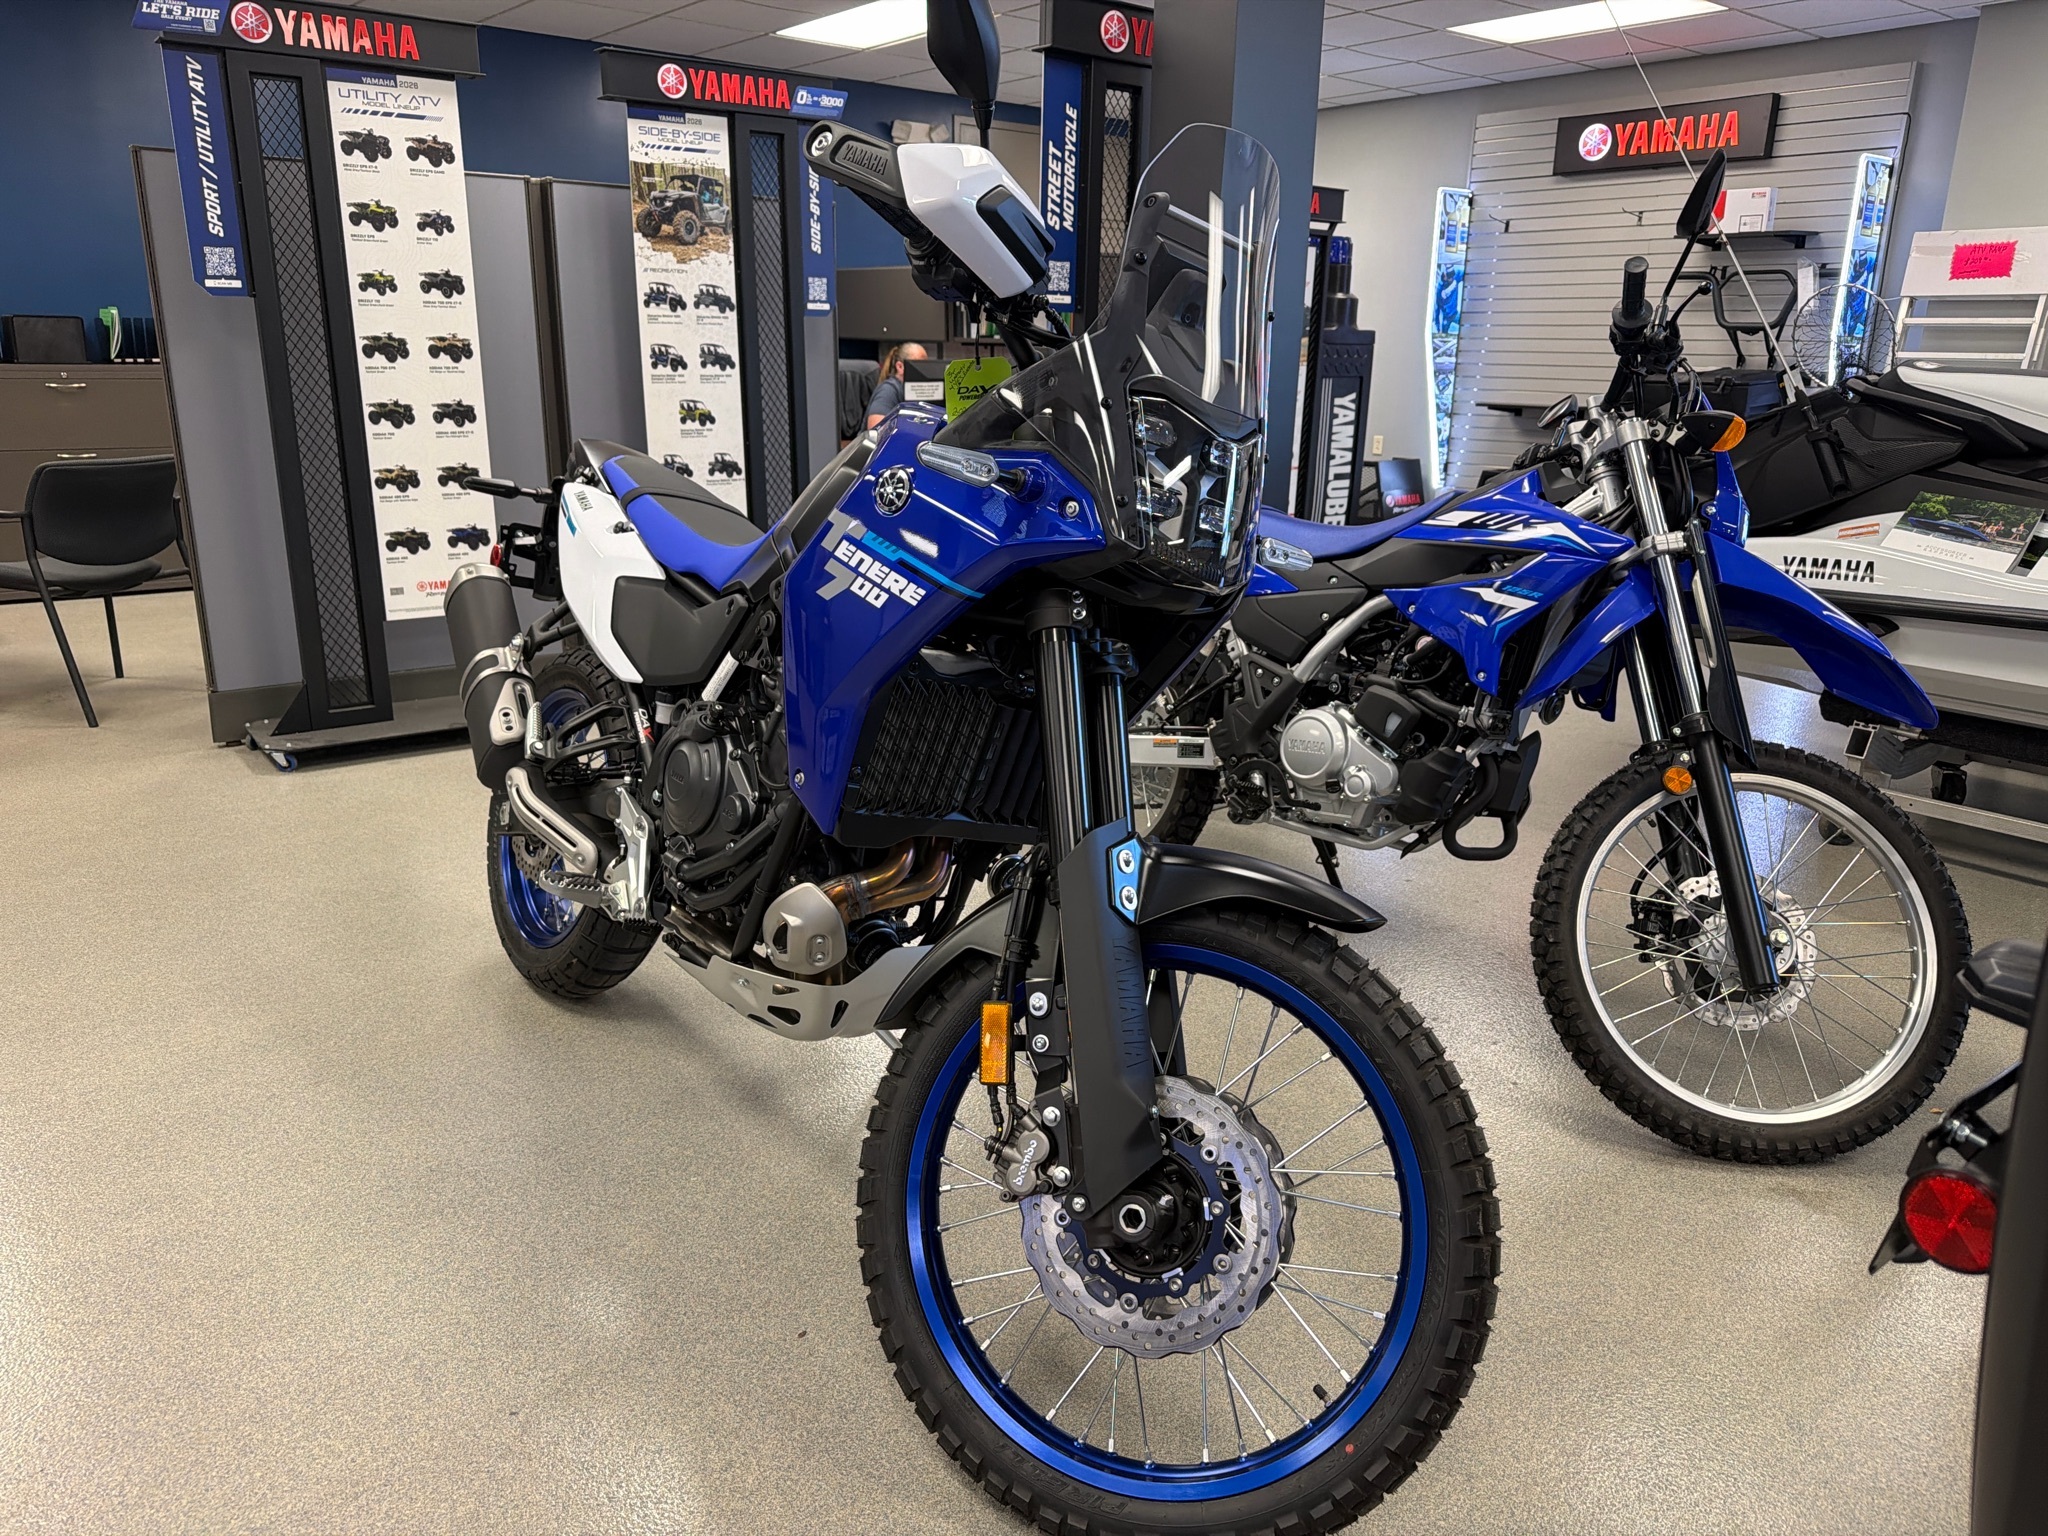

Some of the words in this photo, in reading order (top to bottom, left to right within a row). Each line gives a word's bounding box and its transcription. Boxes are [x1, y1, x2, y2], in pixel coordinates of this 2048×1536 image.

[142, 2, 182, 16] LET'S
[186, 6, 220, 20] RIDE
[274, 8, 420, 60] YAMAHA
[186, 55, 206, 96] ATV
[362, 77, 396, 86] YAMAHA
[688, 68, 790, 110] YAMAHA
[338, 88, 402, 102] UTILITY
[409, 96, 441, 106] ATV
[190, 94, 214, 164] UTILITY
[638, 126, 720, 142] SIDE-BY-SIDE
[658, 115, 684, 123] YAMAHA
[1615, 110, 1739, 156] YAMAHA
[842, 144, 888, 176] YAMAHA
[1062, 103, 1078, 232] MOTORCYCLE
[1047, 140, 1062, 230] STREET
[202, 177, 224, 238] SPORT
[809, 164, 822, 254] SIDE-BY-SI
[1323, 392, 1357, 526] YAMALUBE
[574, 490, 594, 512] YAMAHA
[1783, 556, 1875, 584] YAMAHA
[1288, 739, 1325, 754] YAMAHA
[1016, 1140, 1037, 1186] brembo
